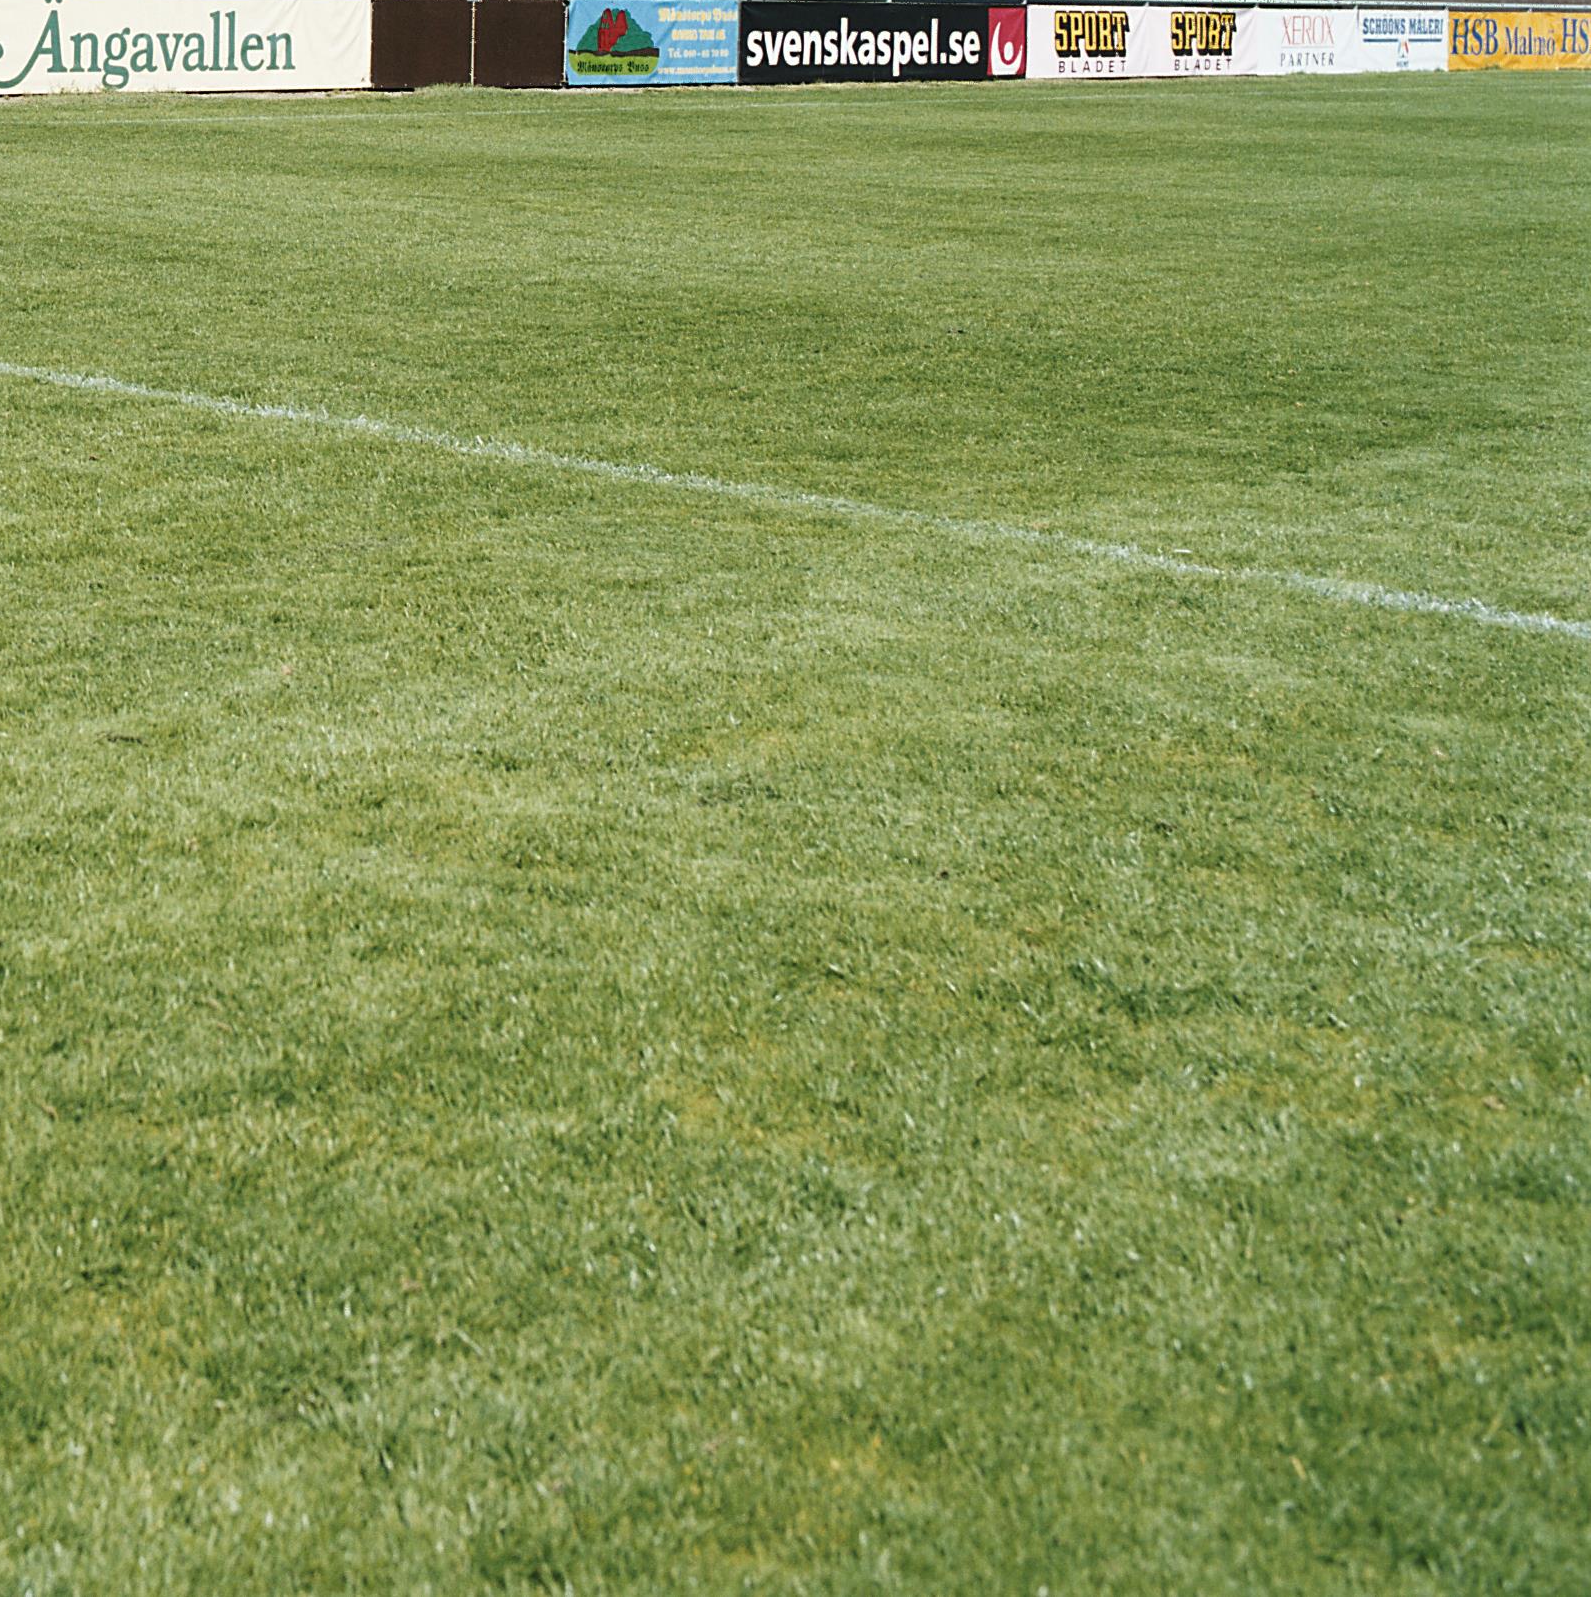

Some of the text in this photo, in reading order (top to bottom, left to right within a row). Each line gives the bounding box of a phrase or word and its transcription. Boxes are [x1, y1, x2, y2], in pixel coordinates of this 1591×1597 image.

[1054, 10, 1130, 58] SPORT
[1171, 11, 1237, 57] SPORT
[1281, 15, 1335, 46] XEROX
[1362, 13, 1444, 35] SCHÖÖNS MÅLERI
[1451, 17, 1591, 56] HSB Malmö HS
[746, 16, 980, 77] svenskaspel.se
[1280, 52, 1335, 68] PARTNER
[1058, 60, 1127, 74] BLADET
[1174, 58, 1233, 71] BLADET
